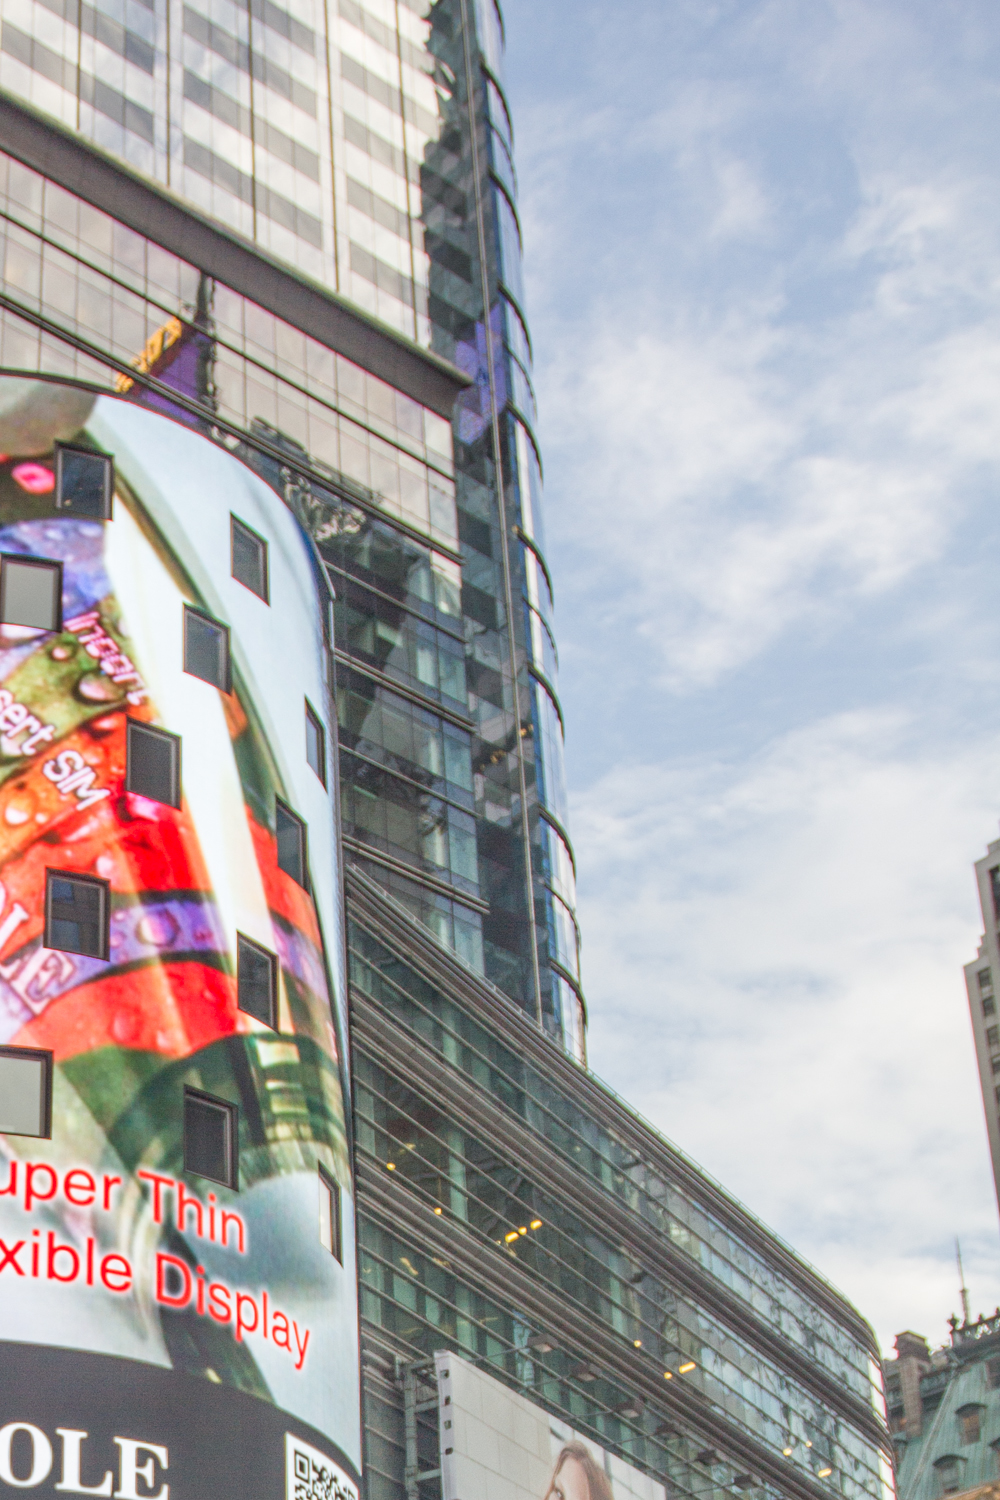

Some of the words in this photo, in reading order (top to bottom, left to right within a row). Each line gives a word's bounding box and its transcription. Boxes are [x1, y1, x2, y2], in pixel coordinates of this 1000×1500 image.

[43, 750, 111, 811] SIM
[136, 1170, 247, 1254] Thin
[154, 1253, 311, 1371] Display
